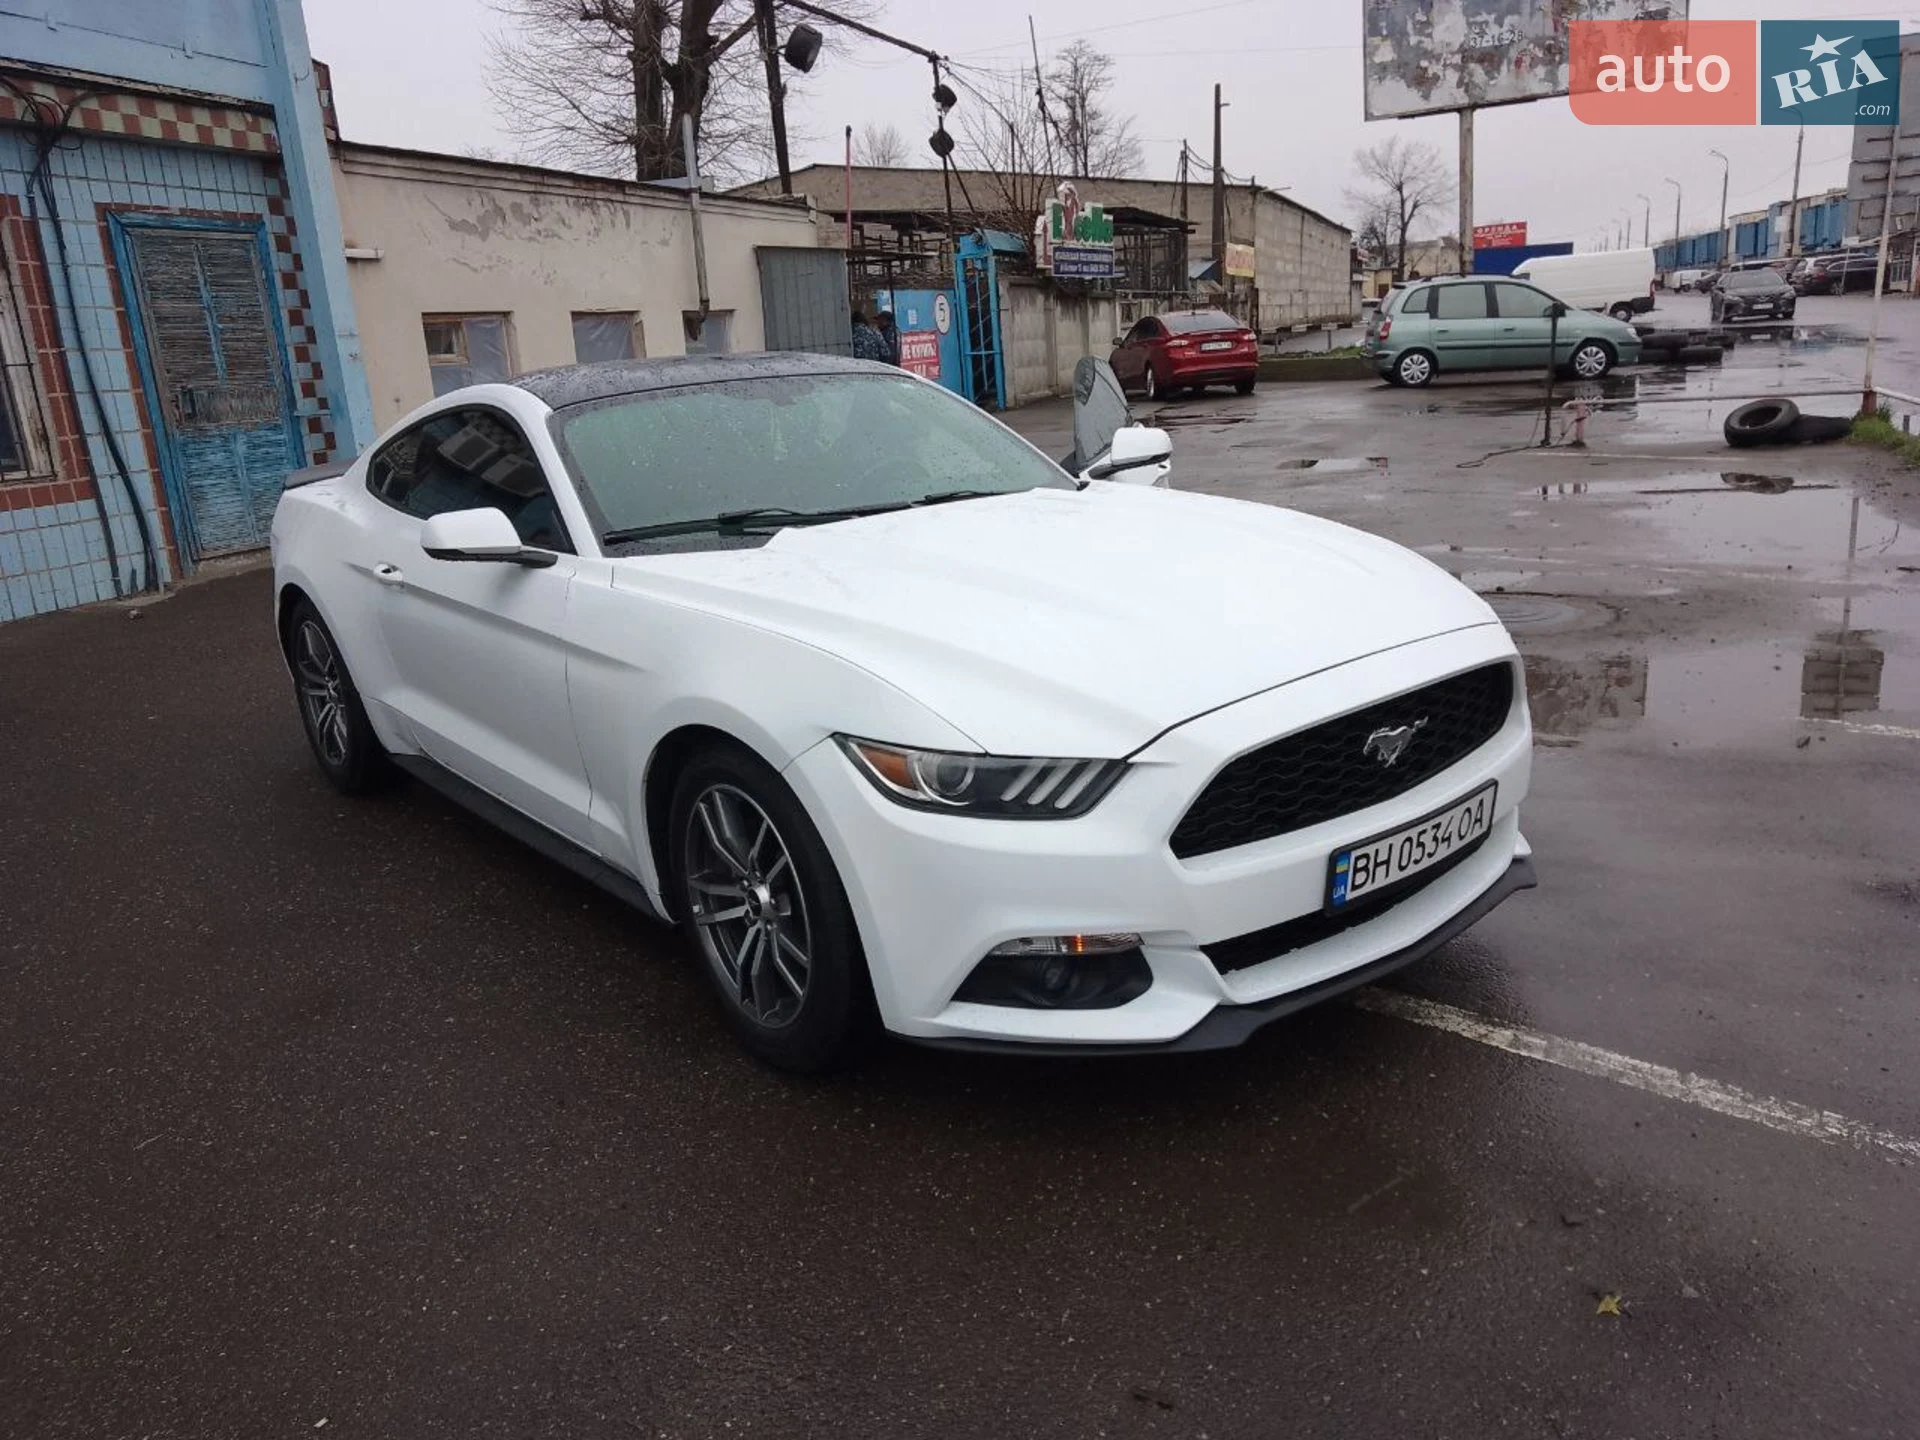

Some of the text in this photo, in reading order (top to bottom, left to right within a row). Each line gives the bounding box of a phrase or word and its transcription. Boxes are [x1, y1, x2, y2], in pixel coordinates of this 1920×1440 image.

[1351, 798, 1485, 892] BH 0534 OA
[1333, 885, 1347, 898] UA
